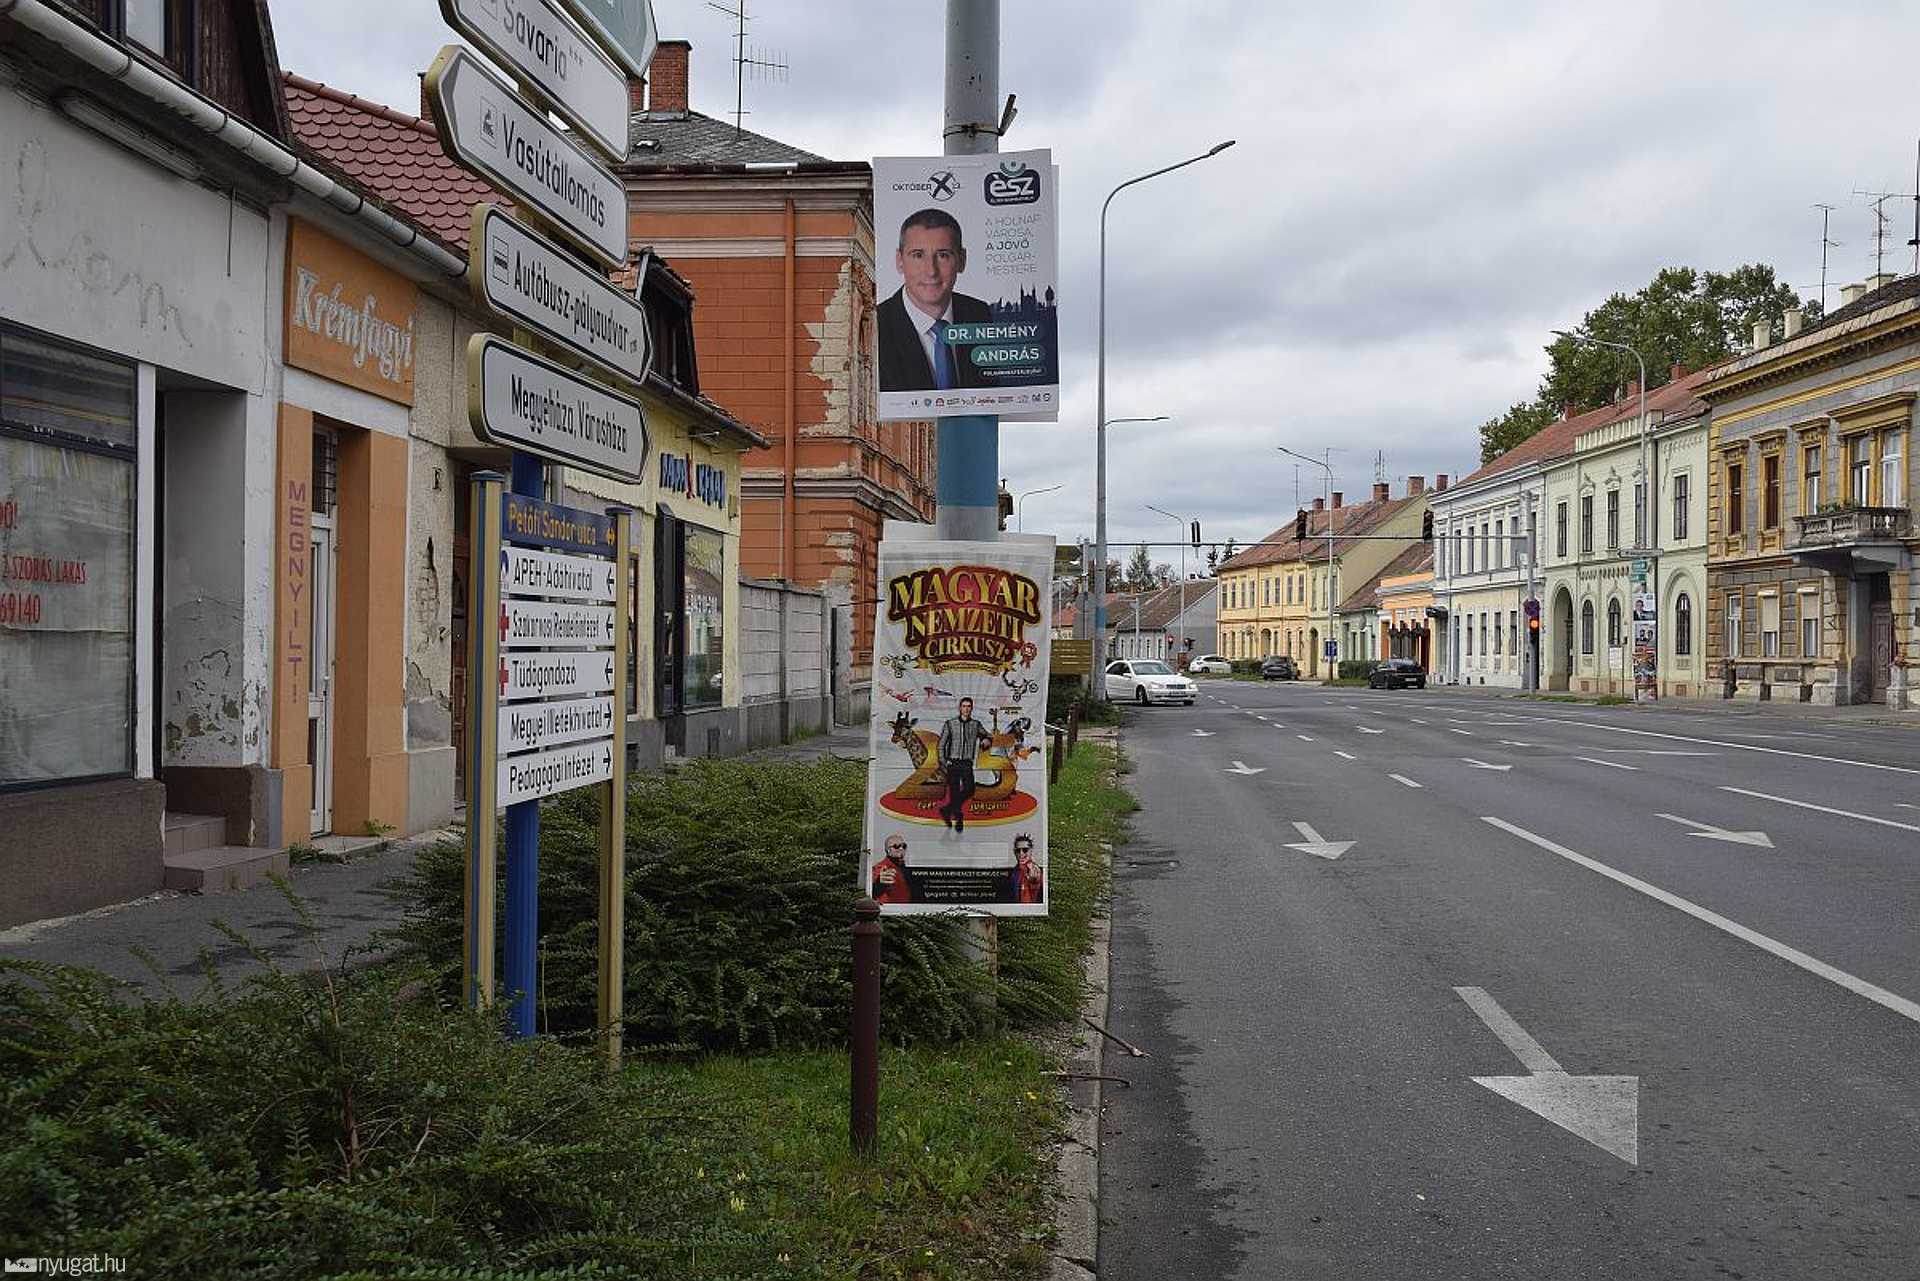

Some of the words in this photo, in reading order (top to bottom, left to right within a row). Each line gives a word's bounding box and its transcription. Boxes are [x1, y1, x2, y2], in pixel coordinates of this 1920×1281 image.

[503, 0, 567, 80] Savaria
[503, 113, 605, 228] Vasútállomás
[985, 241, 994, 250] A
[514, 251, 629, 353] Autóbusz-pályaudvar
[294, 266, 414, 383] Krémfagyi
[948, 328, 972, 340] DR.
[975, 323, 1038, 339] NEMÉNY
[977, 346, 1040, 362] ANDRÁS
[577, 400, 628, 454] Városháza
[508, 502, 541, 537] Petőfi
[577, 521, 597, 546] utca
[13, 554, 52, 584] SZOBÁS
[894, 571, 1037, 618] MAGYAR
[910, 607, 1023, 642] NEMZETI
[924, 635, 1010, 660] CIRKUSZ
[512, 658, 577, 694] Tüdőgondozó
